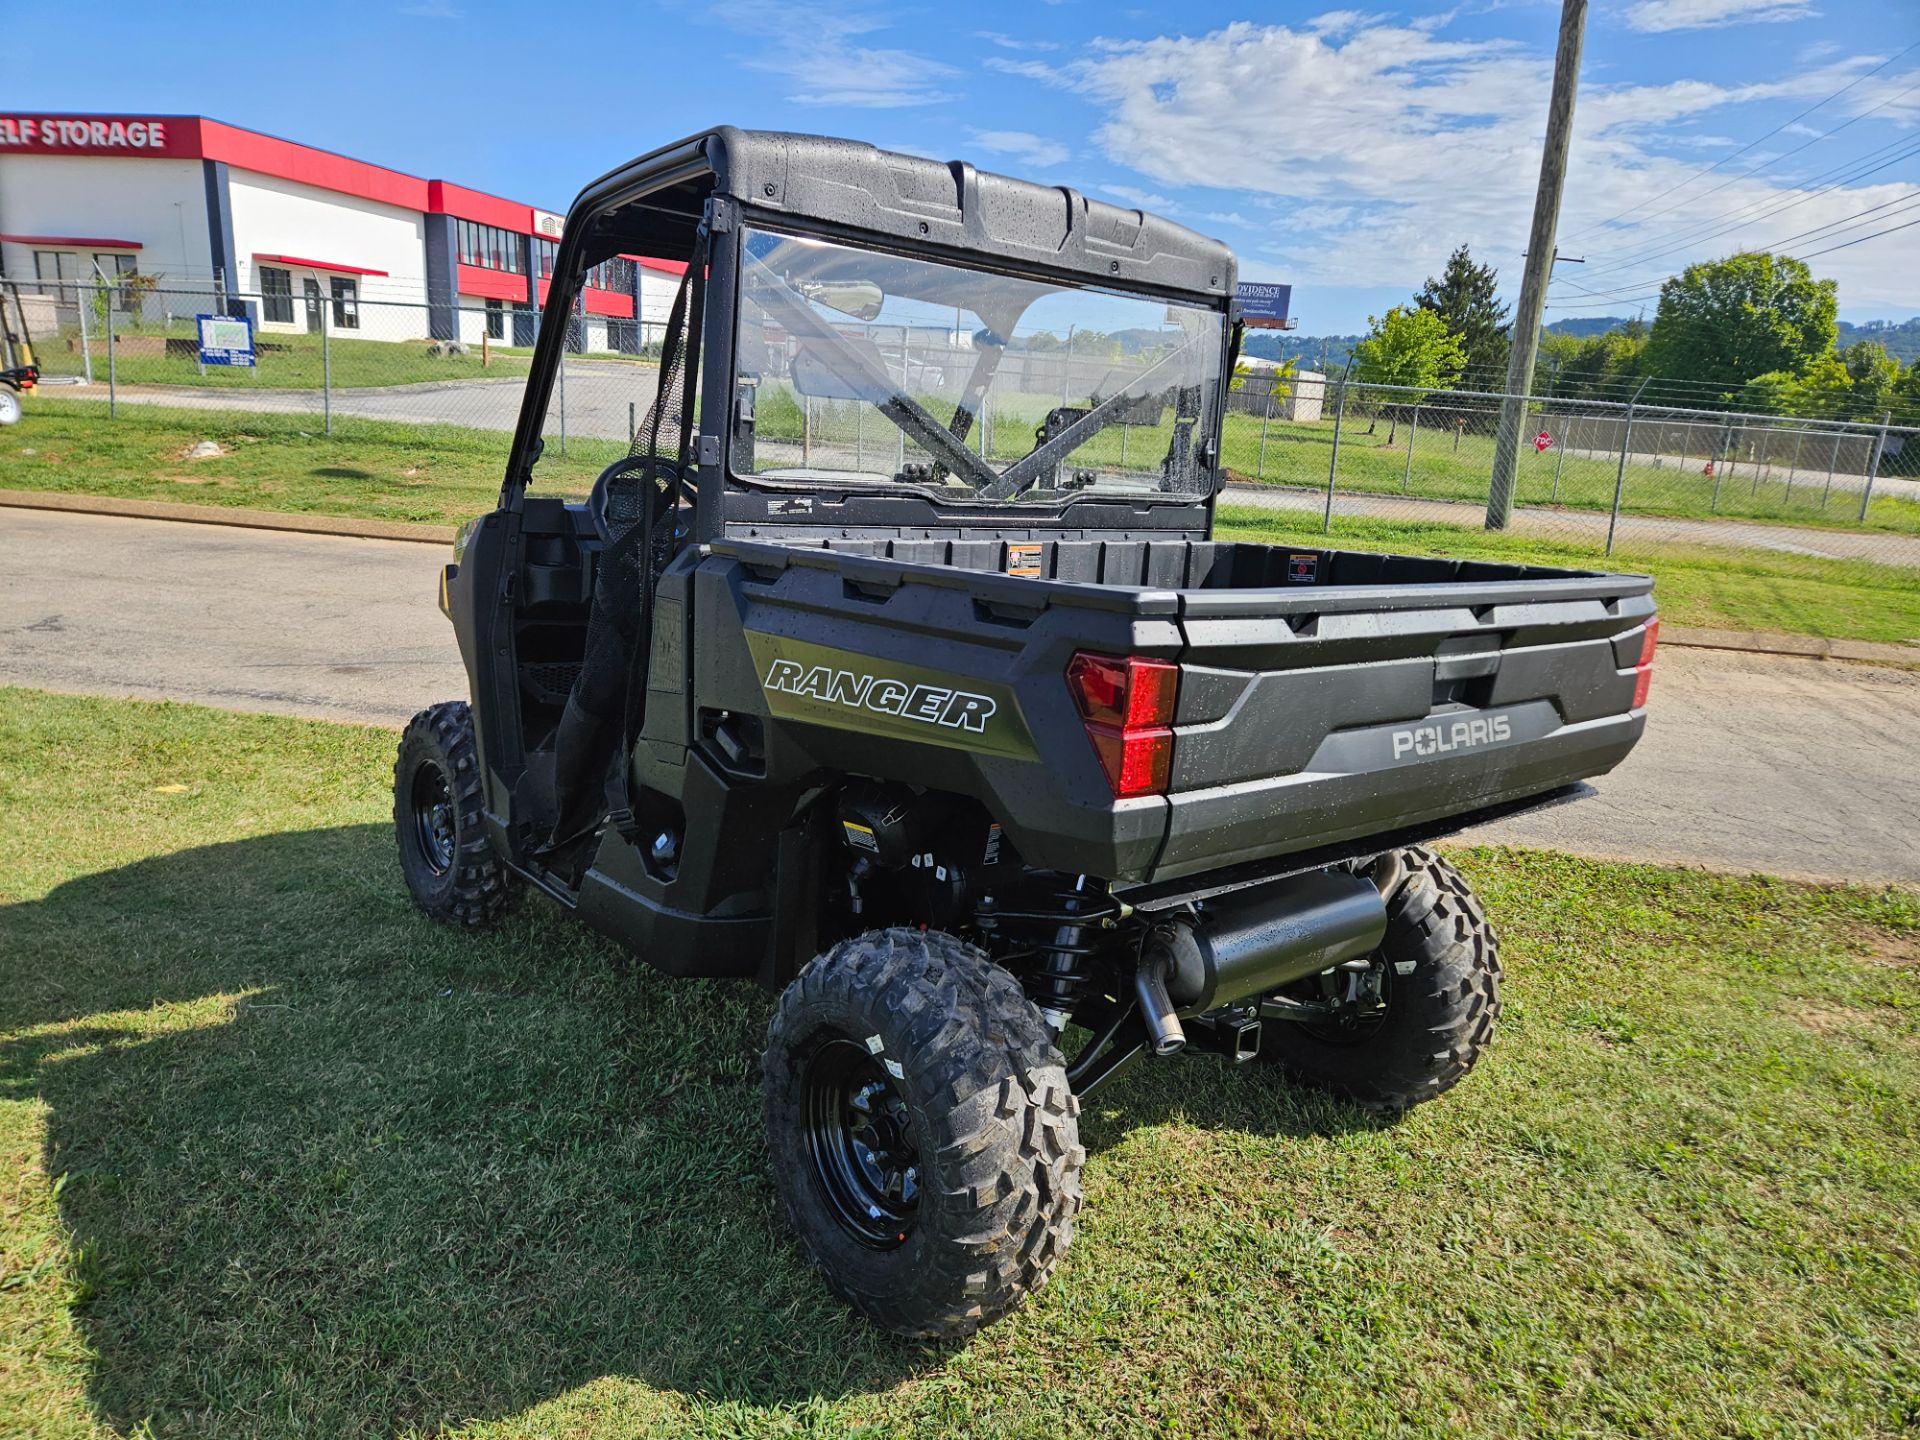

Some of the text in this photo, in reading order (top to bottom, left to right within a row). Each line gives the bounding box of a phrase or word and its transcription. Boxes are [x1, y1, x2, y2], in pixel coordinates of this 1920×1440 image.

[40, 120, 164, 147] STORAGE
[1535, 437, 1551, 445] FDC
[764, 659, 997, 733] RANGER
[1392, 715, 1511, 760] POLARIS
